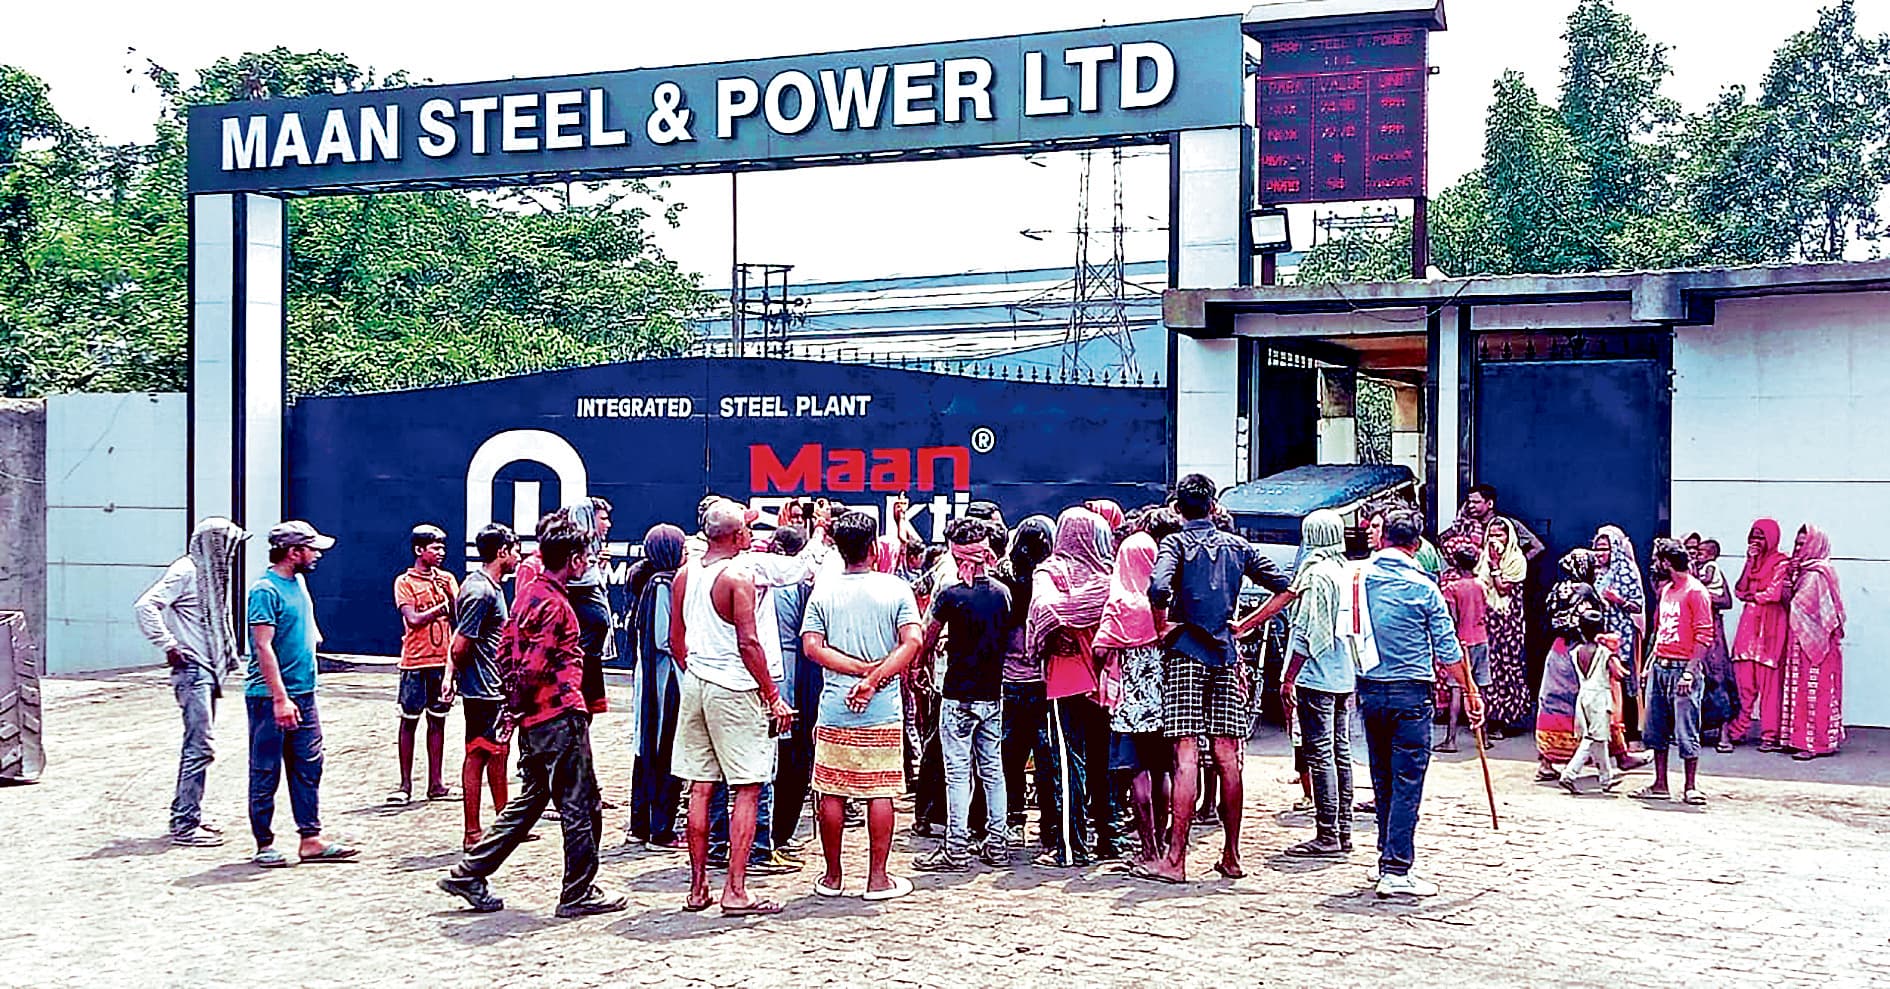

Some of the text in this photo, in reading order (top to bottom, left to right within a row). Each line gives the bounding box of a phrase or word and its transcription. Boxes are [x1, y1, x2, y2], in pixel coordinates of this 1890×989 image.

[220, 41, 1175, 171] MAAN STEEL & POWER LTD
[577, 395, 871, 418] INTEGRATED STEEL PLANT
[749, 443, 970, 492] Maan
